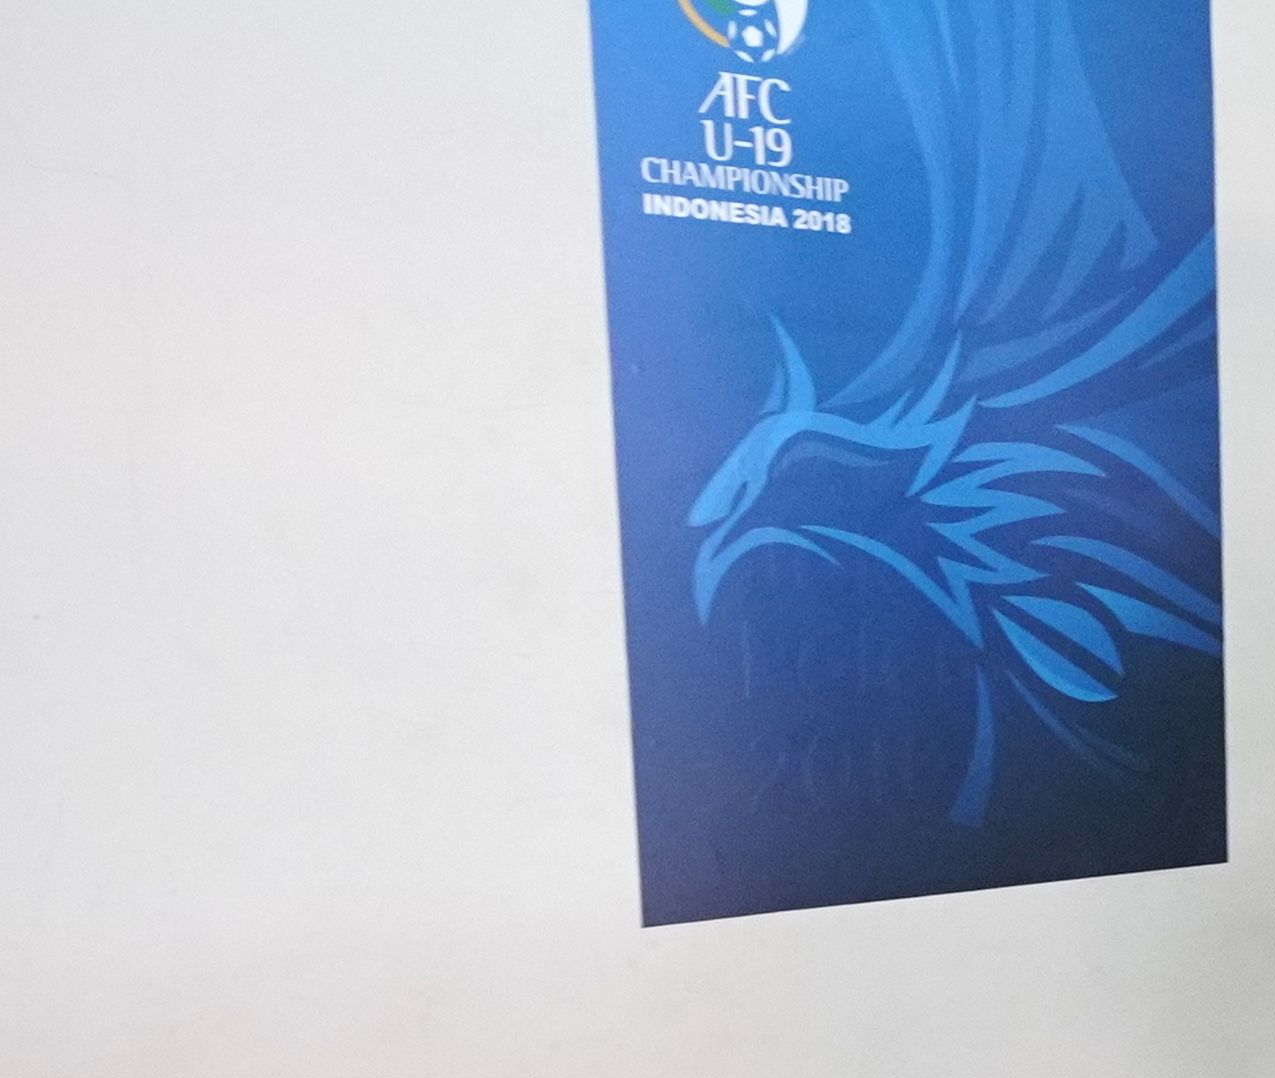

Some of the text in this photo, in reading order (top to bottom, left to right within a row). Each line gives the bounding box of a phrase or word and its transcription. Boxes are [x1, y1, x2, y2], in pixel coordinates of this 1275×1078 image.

[699, 72, 791, 124] AFC
[700, 119, 793, 167] U-19
[640, 157, 849, 203] CHAMPIONSHIP
[642, 193, 852, 234] INDONESIA 2018
